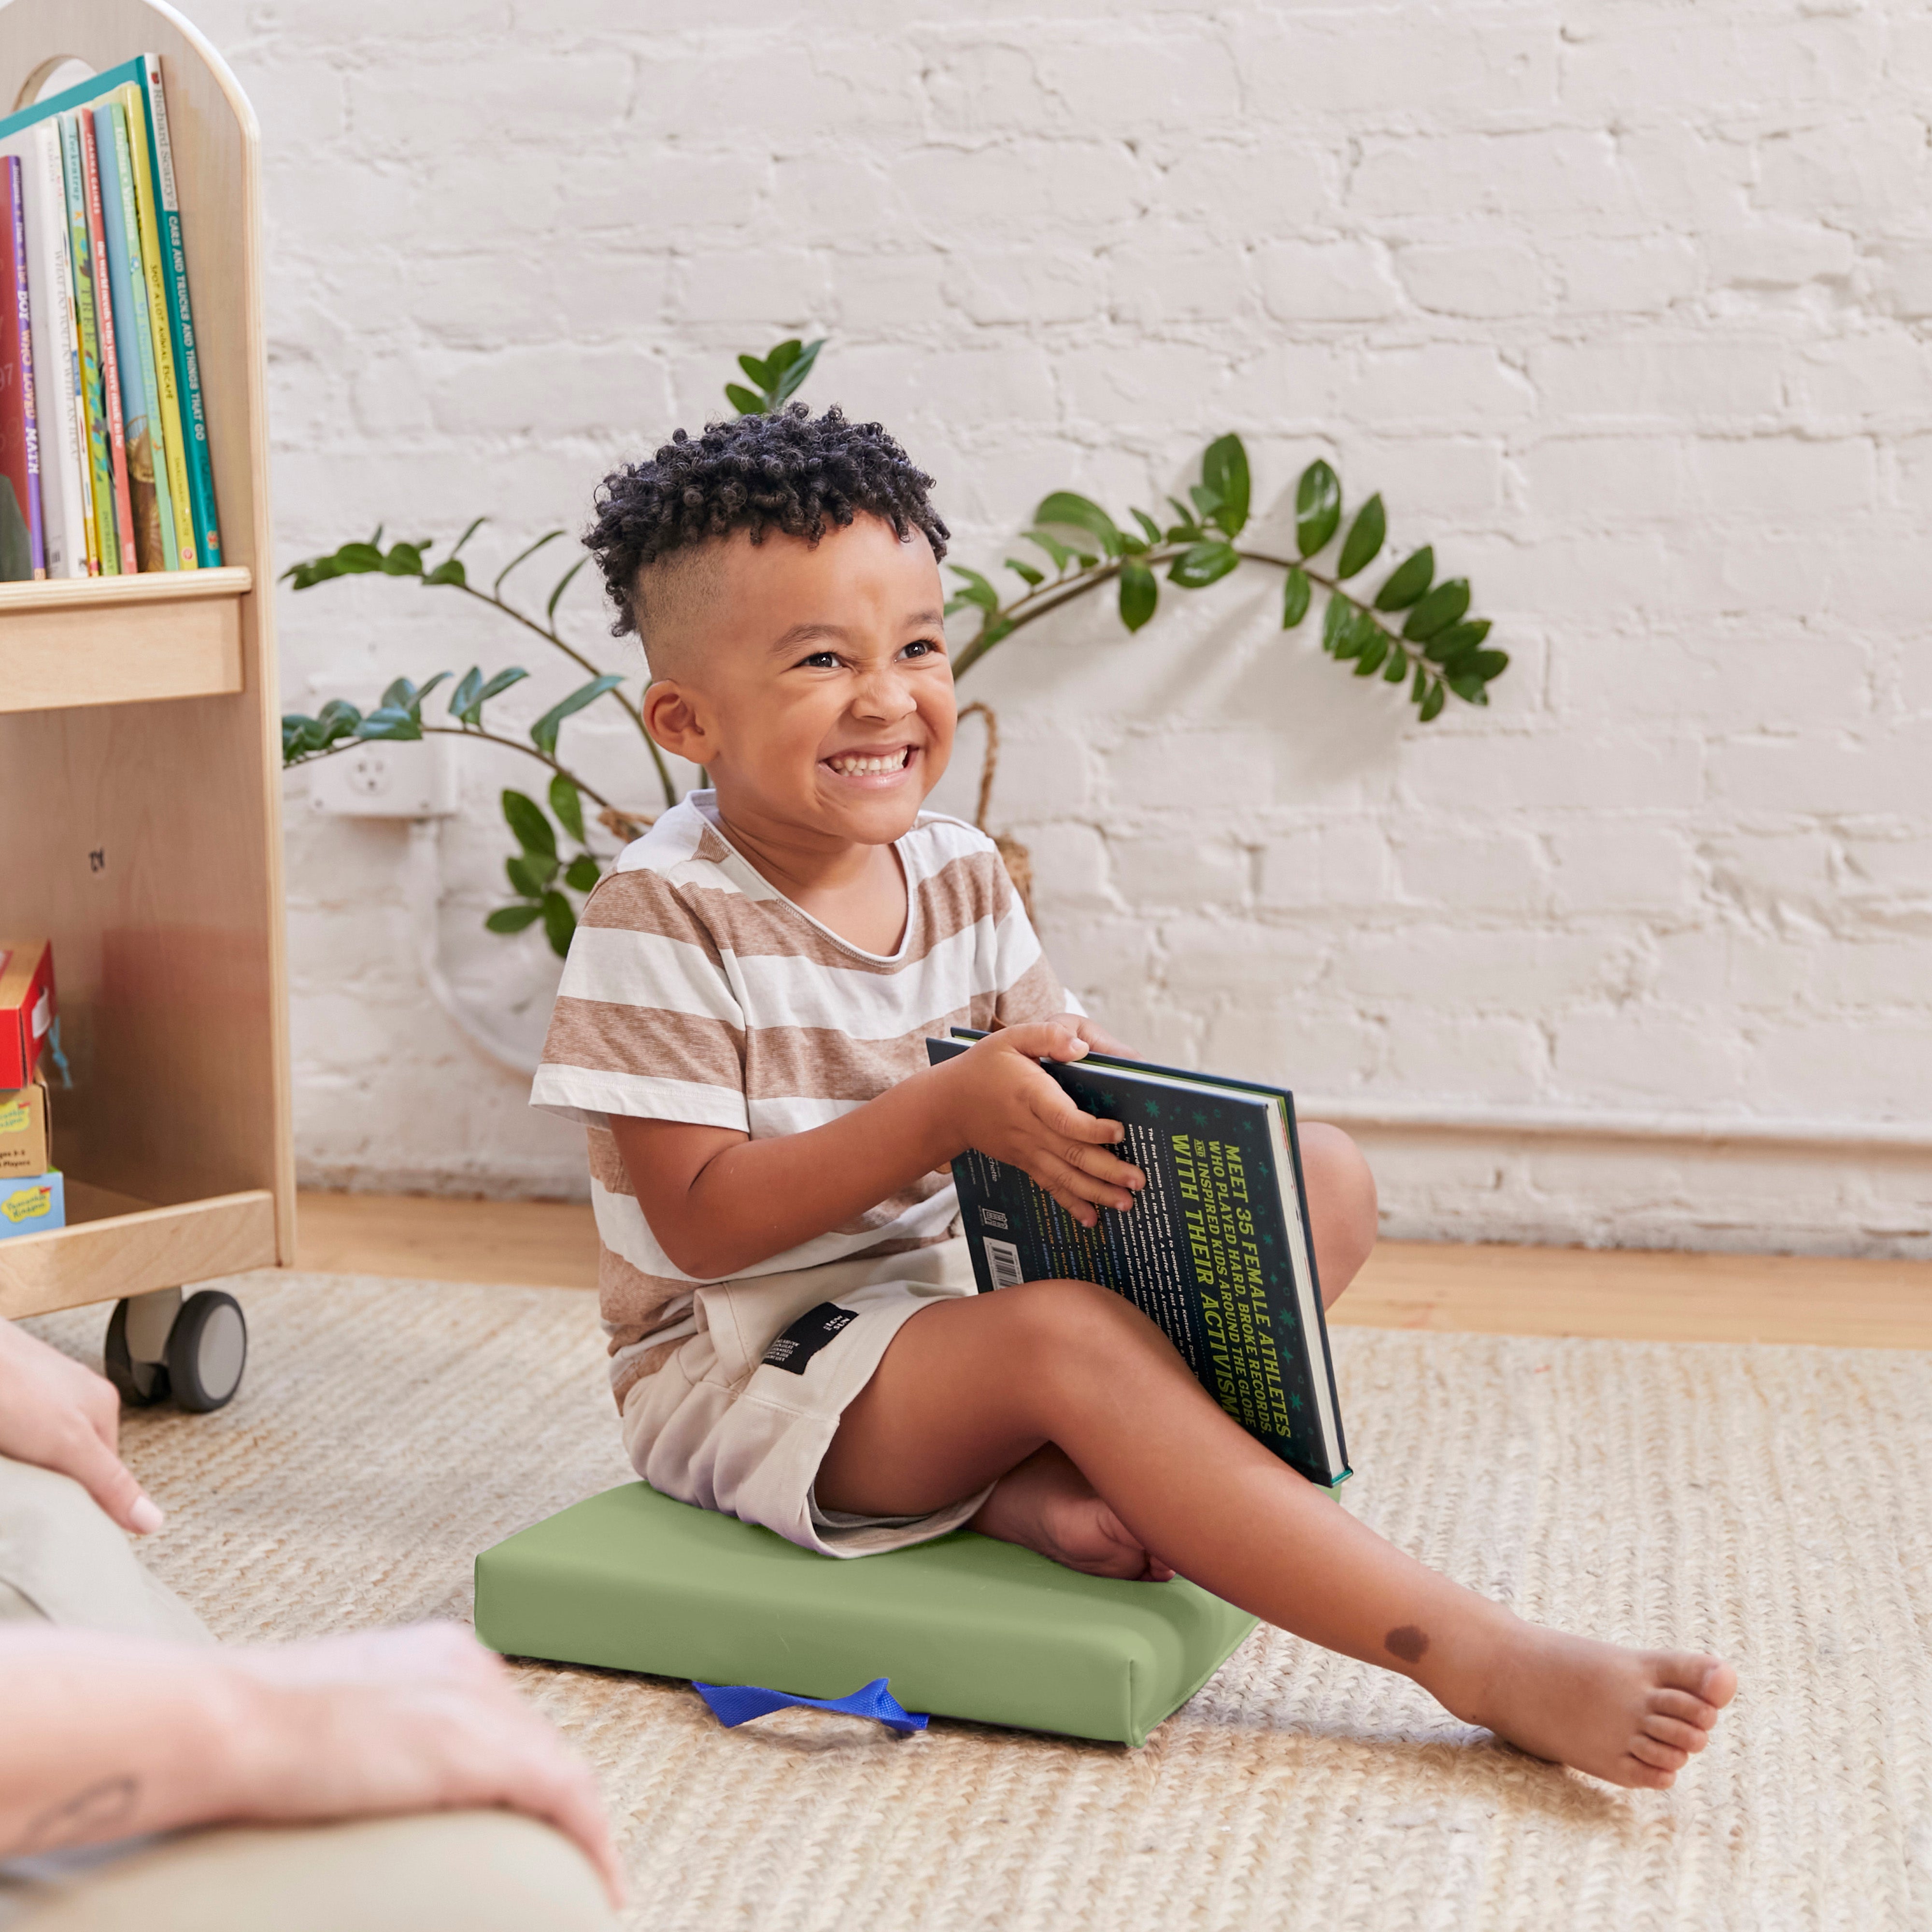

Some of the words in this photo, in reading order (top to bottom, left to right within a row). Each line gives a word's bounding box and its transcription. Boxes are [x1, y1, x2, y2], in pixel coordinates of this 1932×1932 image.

[152, 88, 168, 144] Richard
[159, 151, 175, 208] Scarry's
[168, 215, 180, 247] CARS
[54, 250, 64, 285] WHAT
[150, 264, 159, 289] SPOT
[172, 248, 183, 272] AND
[17, 289, 29, 322] BOY
[57, 290, 67, 309] DO
[80, 287, 96, 343] TREE
[155, 302, 163, 321] LOT
[175, 275, 189, 321] TRUCKS
[59, 314, 70, 339] YOU
[157, 326, 168, 361] ANIMAL
[181, 322, 193, 347] AND
[20, 329, 31, 367] WHO
[61, 342, 71, 363] DO
[162, 364, 173, 400] ESCAPE
[185, 350, 198, 390] THINGS
[22, 370, 35, 421] LOVED
[190, 392, 202, 421] THAT
[194, 423, 204, 441] GO
[25, 426, 39, 475] MATH
[1122, 1145, 1128, 1154] an
[1140, 1142, 1150, 1165] tennis
[1193, 1138, 1206, 1158] AND
[1208, 1138, 1225, 1178] WHO
[987, 1156, 998, 1182] chette
[1144, 1166, 1154, 1191] player
[1153, 1161, 1163, 1188] woman
[1170, 1131, 1199, 1201] WITH
[1223, 1144, 1249, 1203] MEET
[1159, 1190, 1167, 1211] horse
[1197, 1161, 1221, 1236] INSPIRED
[1215, 1181, 1237, 1245] PLAYED
[1040, 1193, 1049, 1217] MYERS
[1045, 1218, 1054, 1244] TAYLOR
[1048, 1193, 1057, 1215] ONDA
[1053, 1216, 1063, 1245] ROUSEY
[1060, 1251, 1069, 1275] WILMA
[1128, 1123, 1140, 1166] snowboarde
[1140, 1189, 1149, 1214] landed
[1146, 1220, 1160, 1272] death-defying
[1155, 1271, 1164, 1293] jump.
[1161, 1300, 1171, 1329] football
[1154, 1216, 1164, 1240] world.
[1163, 1213, 1172, 1237] jockey
[1235, 1206, 1254, 1236] 35
[1035, 1208, 1044, 1236] WELTER
[1041, 1242, 1051, 1270] SERENA
[1061, 1214, 1071, 1244] PATRICK
[1068, 1250, 1078, 1275] MEGAN
[1070, 1214, 1080, 1243] UMANN
[1077, 1250, 1086, 1275] NANCY
[1090, 1227, 1099, 1251] PARZA
[1097, 1220, 1106, 1245] CRUMP
[1103, 1251, 1112, 1275] SASHA
[1104, 1212, 1116, 1250] GRETCHEN
[1111, 1250, 1122, 1279] BLEILER
[1122, 1236, 1130, 1256] using
[1126, 1210, 1137, 1247] ailblazers
[1133, 1247, 1139, 1257] on
[1137, 1270, 1146, 1289] field,
[1138, 1230, 1150, 1264] ballerina,
[1168, 1239, 1174, 1248] to
[1184, 1207, 1215, 1286] THEIR
[1082, 1234, 1091, 1259] JACKIE
[1087, 1260, 1096, 1283] JOYNE
[1126, 1257, 1134, 1274] their
[1161, 1250, 1169, 1273] surfer
[1169, 1250, 1180, 1282] compete
[1210, 1238, 1228, 1276] KIDS
[1129, 1275, 1140, 1309] platform
[1149, 1280, 1154, 1290] so
[1176, 1284, 1182, 1292] in
[1241, 1240, 1270, 1327] FEMALE
[1150, 1291, 1158, 1311] many
[1219, 1279, 1240, 1343] AROUND
[1181, 1308, 1192, 1342] Kentucky
[1237, 1302, 1258, 1356] BROKE
[1187, 1344, 1197, 1368] Derby.
[1231, 1345, 1247, 1377] THE
[1257, 1331, 1292, 1438] ATHLETES
[1237, 1378, 1256, 1428] GLOBE
